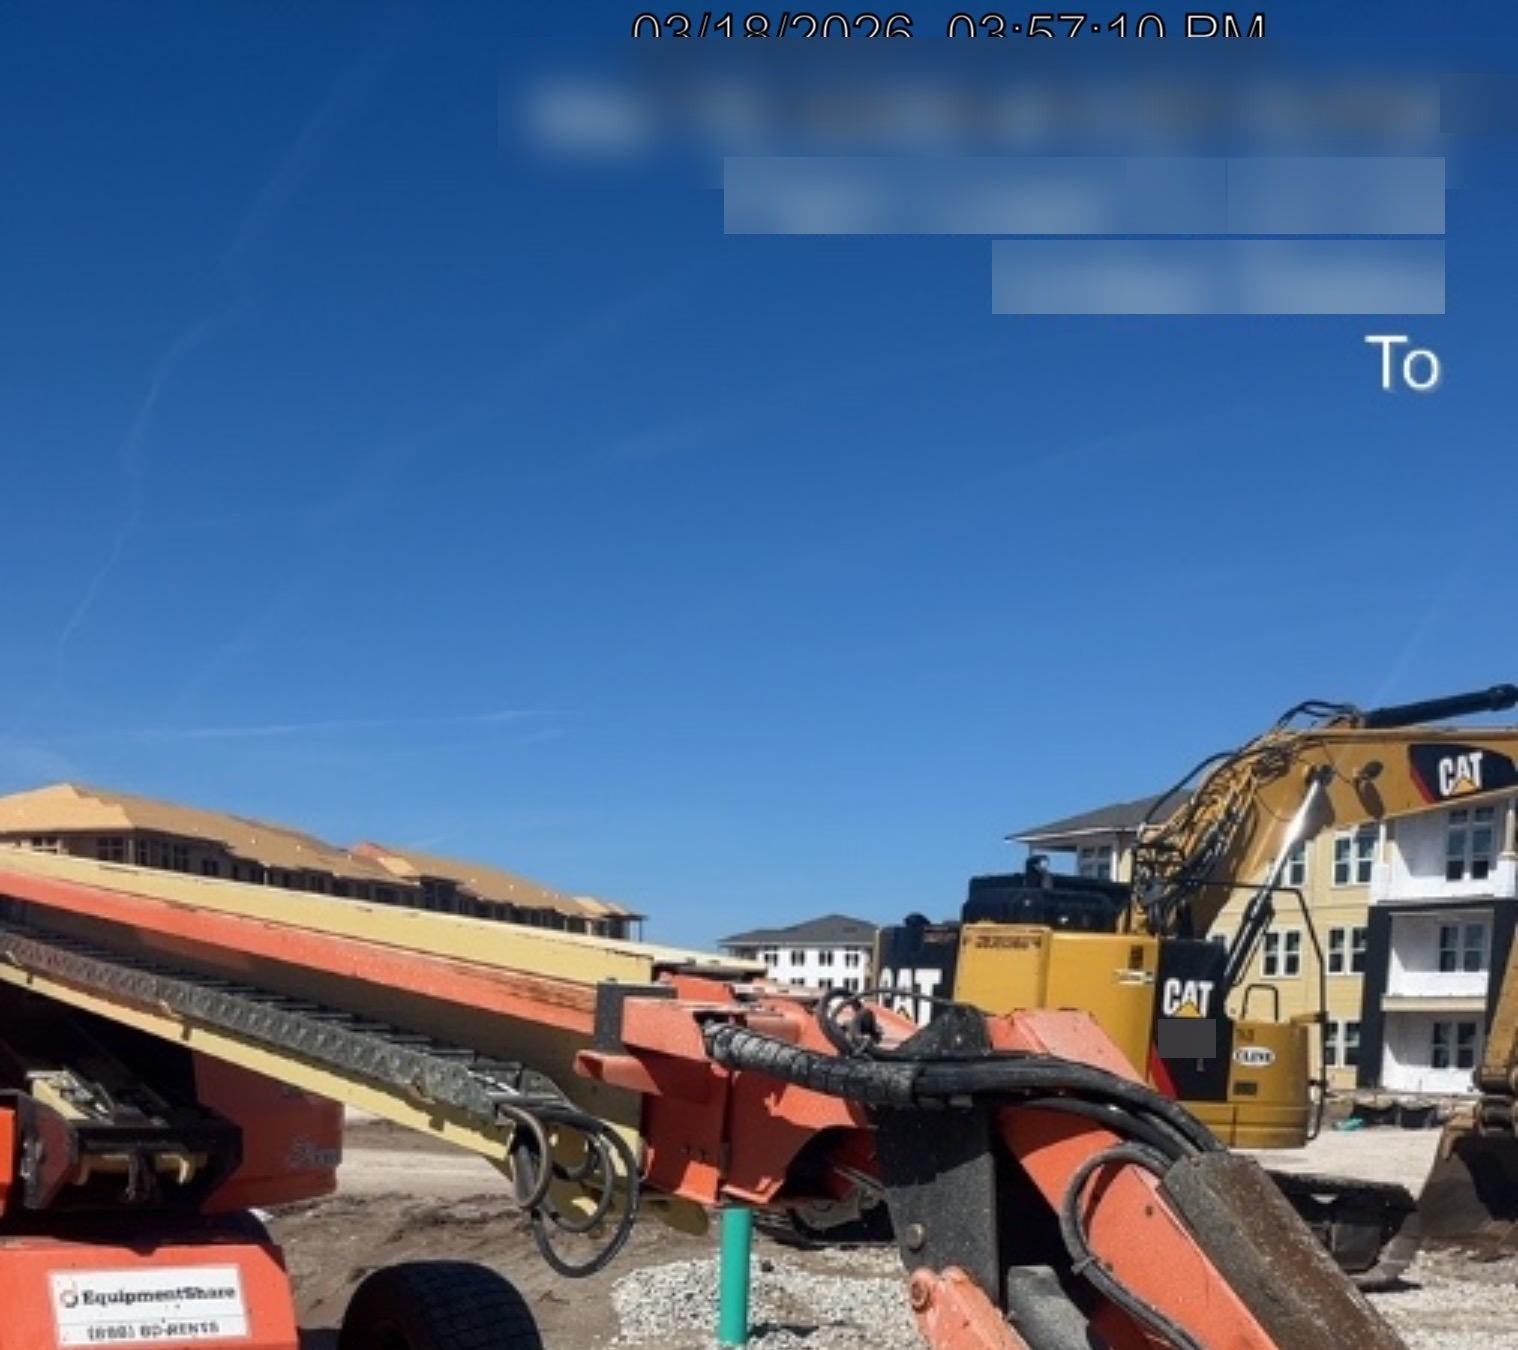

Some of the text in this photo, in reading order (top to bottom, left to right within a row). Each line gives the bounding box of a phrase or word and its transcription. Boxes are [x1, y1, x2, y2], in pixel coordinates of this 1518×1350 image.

[1439, 751, 1483, 796] CAT
[879, 967, 943, 1028] CAT
[1162, 978, 1215, 1018] CAT
[82, 1286, 236, 1307] EquipmentShare
